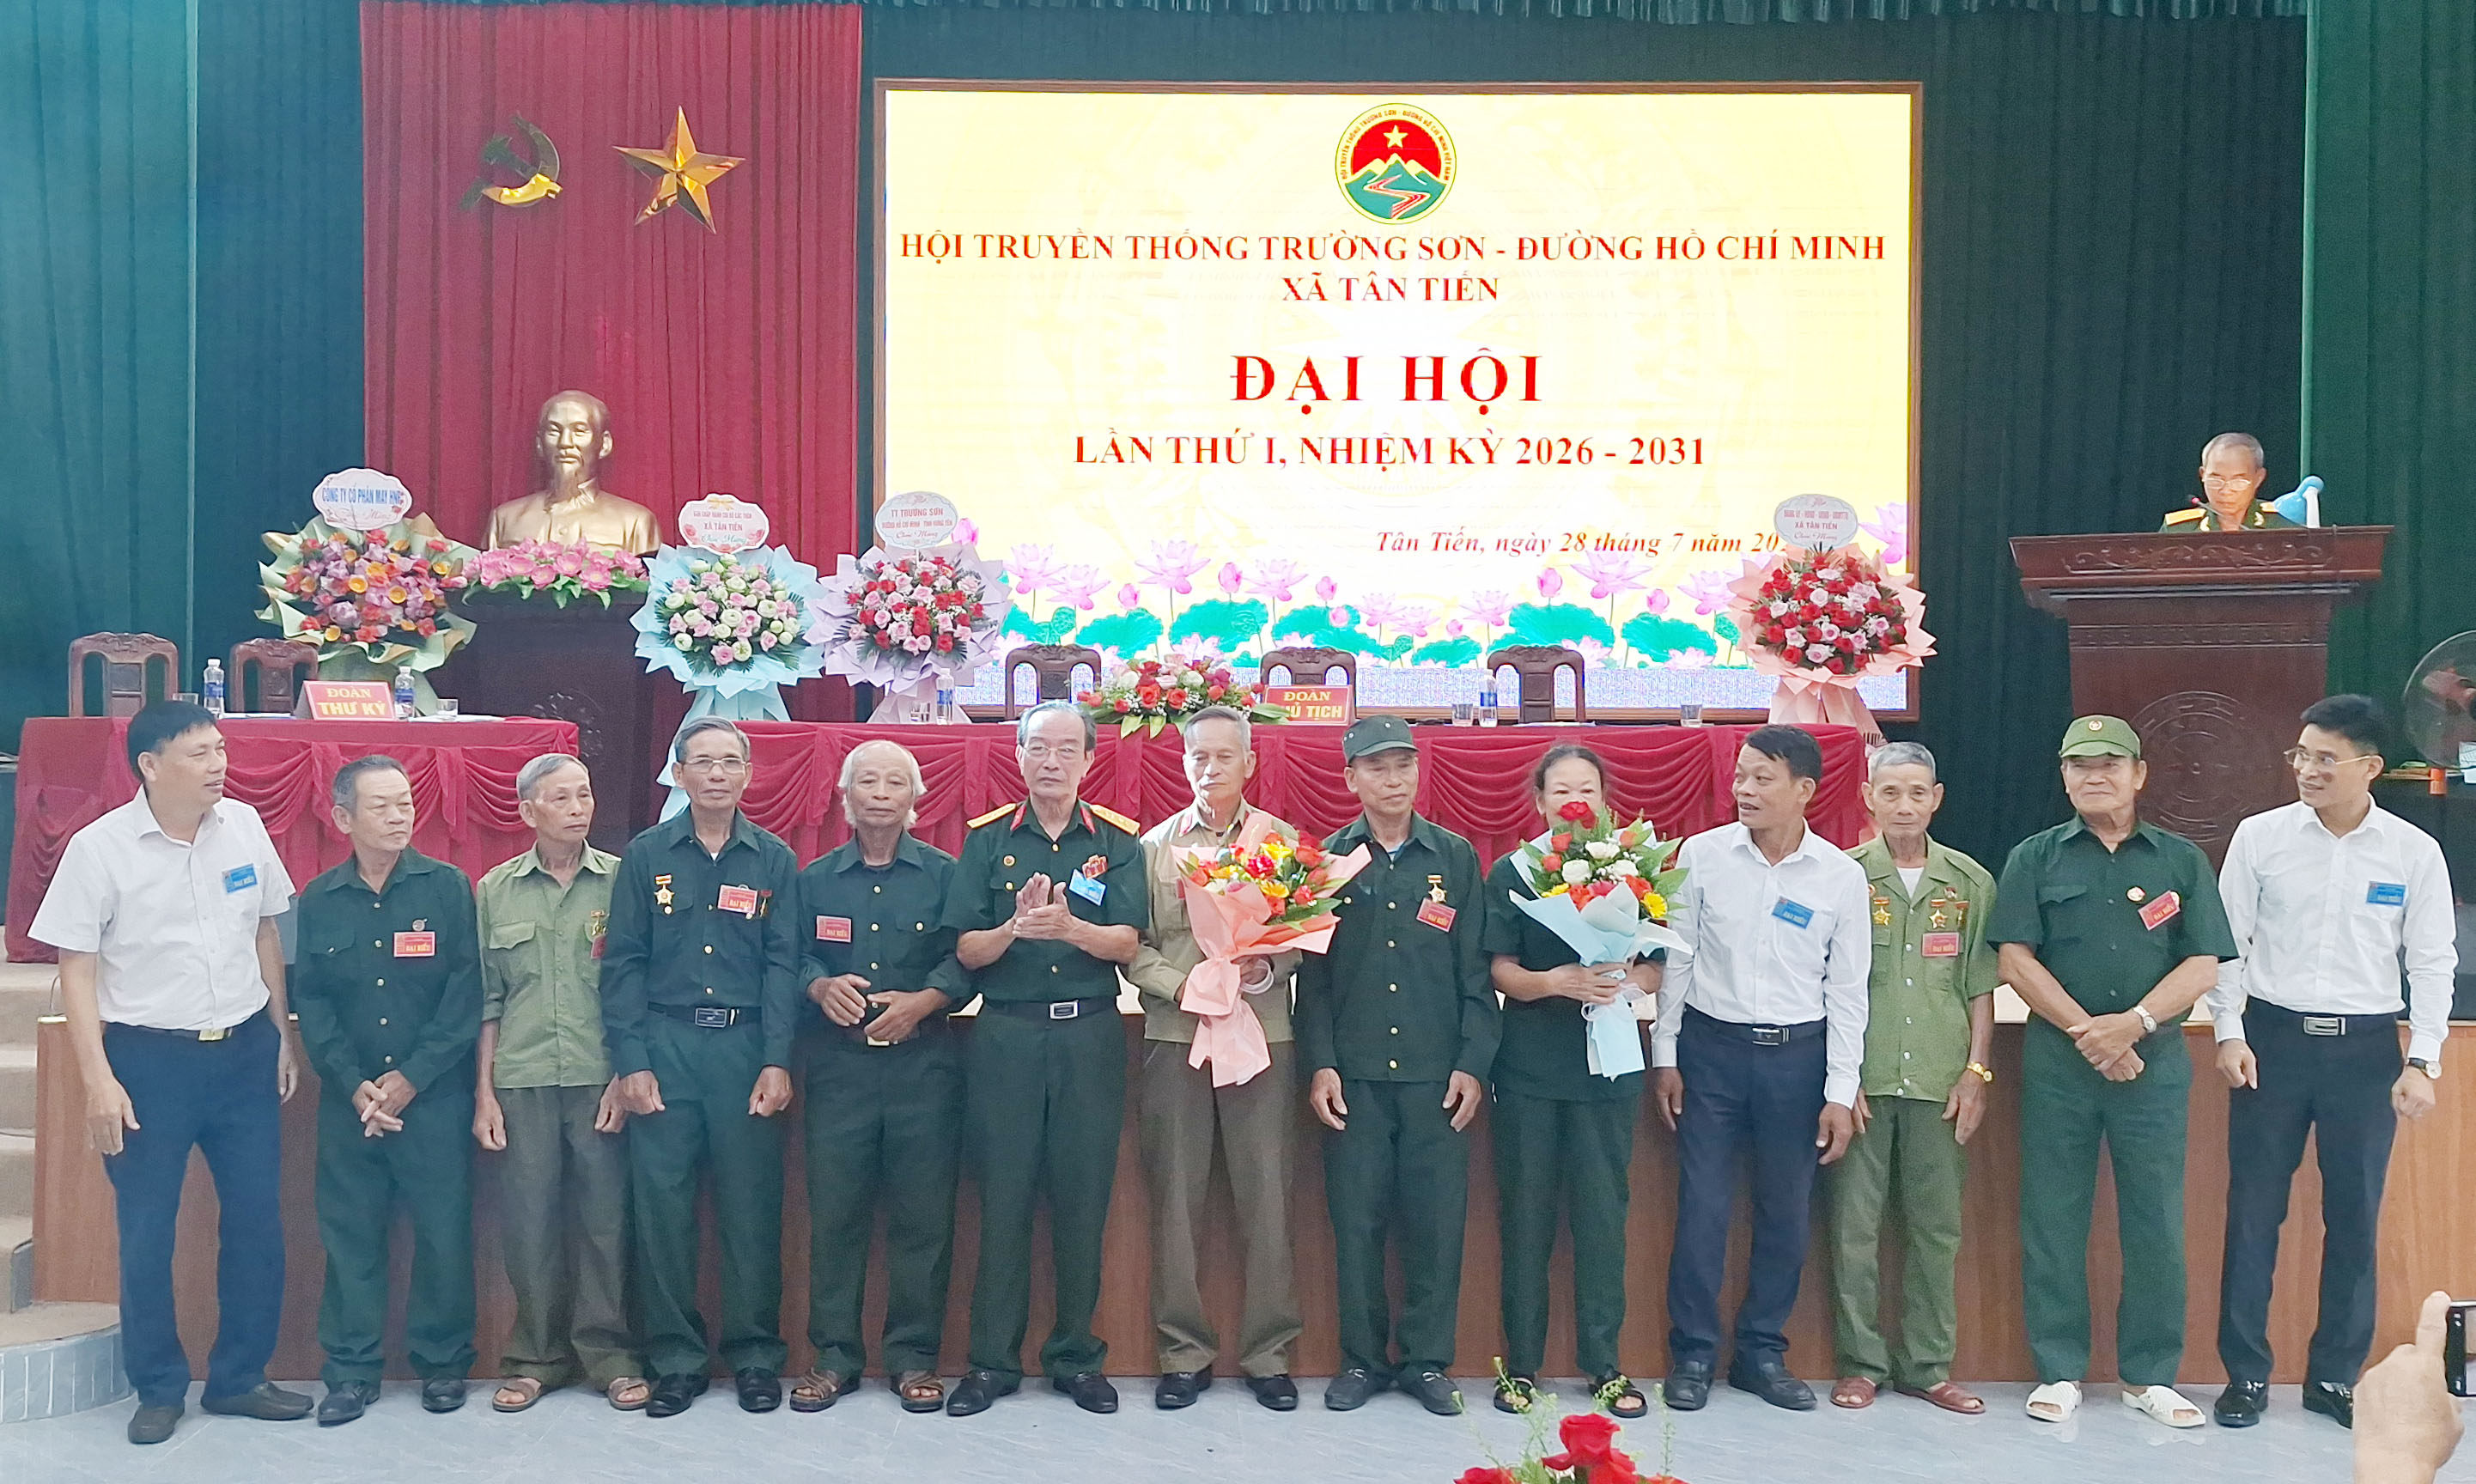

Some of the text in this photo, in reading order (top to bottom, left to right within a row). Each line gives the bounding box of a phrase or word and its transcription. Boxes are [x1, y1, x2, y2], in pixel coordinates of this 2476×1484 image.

[900, 229, 963, 264] HỘI
[974, 228, 1114, 260] TRUYỀN
[1125, 227, 1248, 260] THỐNG
[1259, 229, 1407, 260] TRƯỜNG
[1418, 235, 1486, 260] SƠN
[1517, 229, 1644, 260] ĐƯỜNG
[1656, 228, 1706, 260] HỒ
[1716, 228, 1778, 260] CHÍ
[1791, 235, 1885, 260] MINH
[1282, 270, 1499, 301] XÃ TÂN TIẾN
[1230, 347, 1542, 416] ĐẠI HỘI
[1074, 427, 1153, 464] LẦN
[1165, 427, 1255, 465] THỨ
[1266, 437, 1287, 469] I,
[1299, 433, 1433, 471] NHIỆM
[1449, 428, 1504, 465] KỲ
[1516, 437, 1594, 465] 2026
[1627, 437, 1704, 465] 2031
[340, 488, 347, 503] TY
[1377, 526, 1786, 557] Tân Tiến, ngày 28 tháng 7 năm 20
[325, 686, 372, 698] ĐOÀN
[1284, 689, 1331, 702] ĐOÀN
[317, 701, 357, 715] THƯ
[1306, 705, 1342, 721] TỊCH
